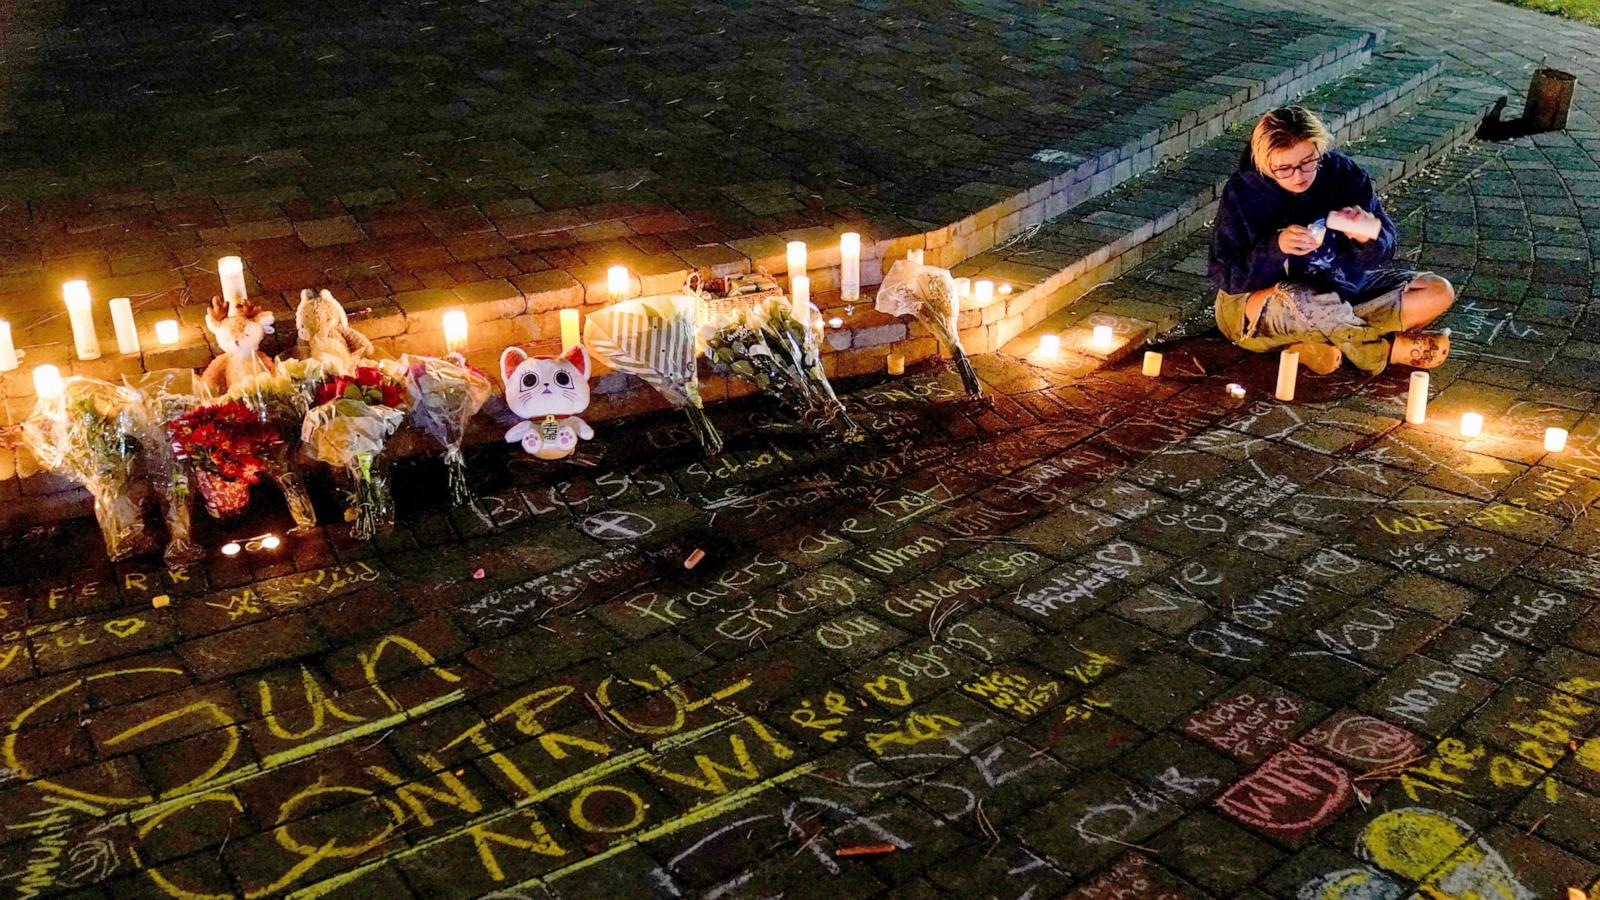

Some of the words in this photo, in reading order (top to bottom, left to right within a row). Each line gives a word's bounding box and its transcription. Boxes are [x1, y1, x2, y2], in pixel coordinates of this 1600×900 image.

[687, 444, 793, 483] School
[130, 664, 752, 900] CONTROL
[469, 715, 795, 882] NOW!
